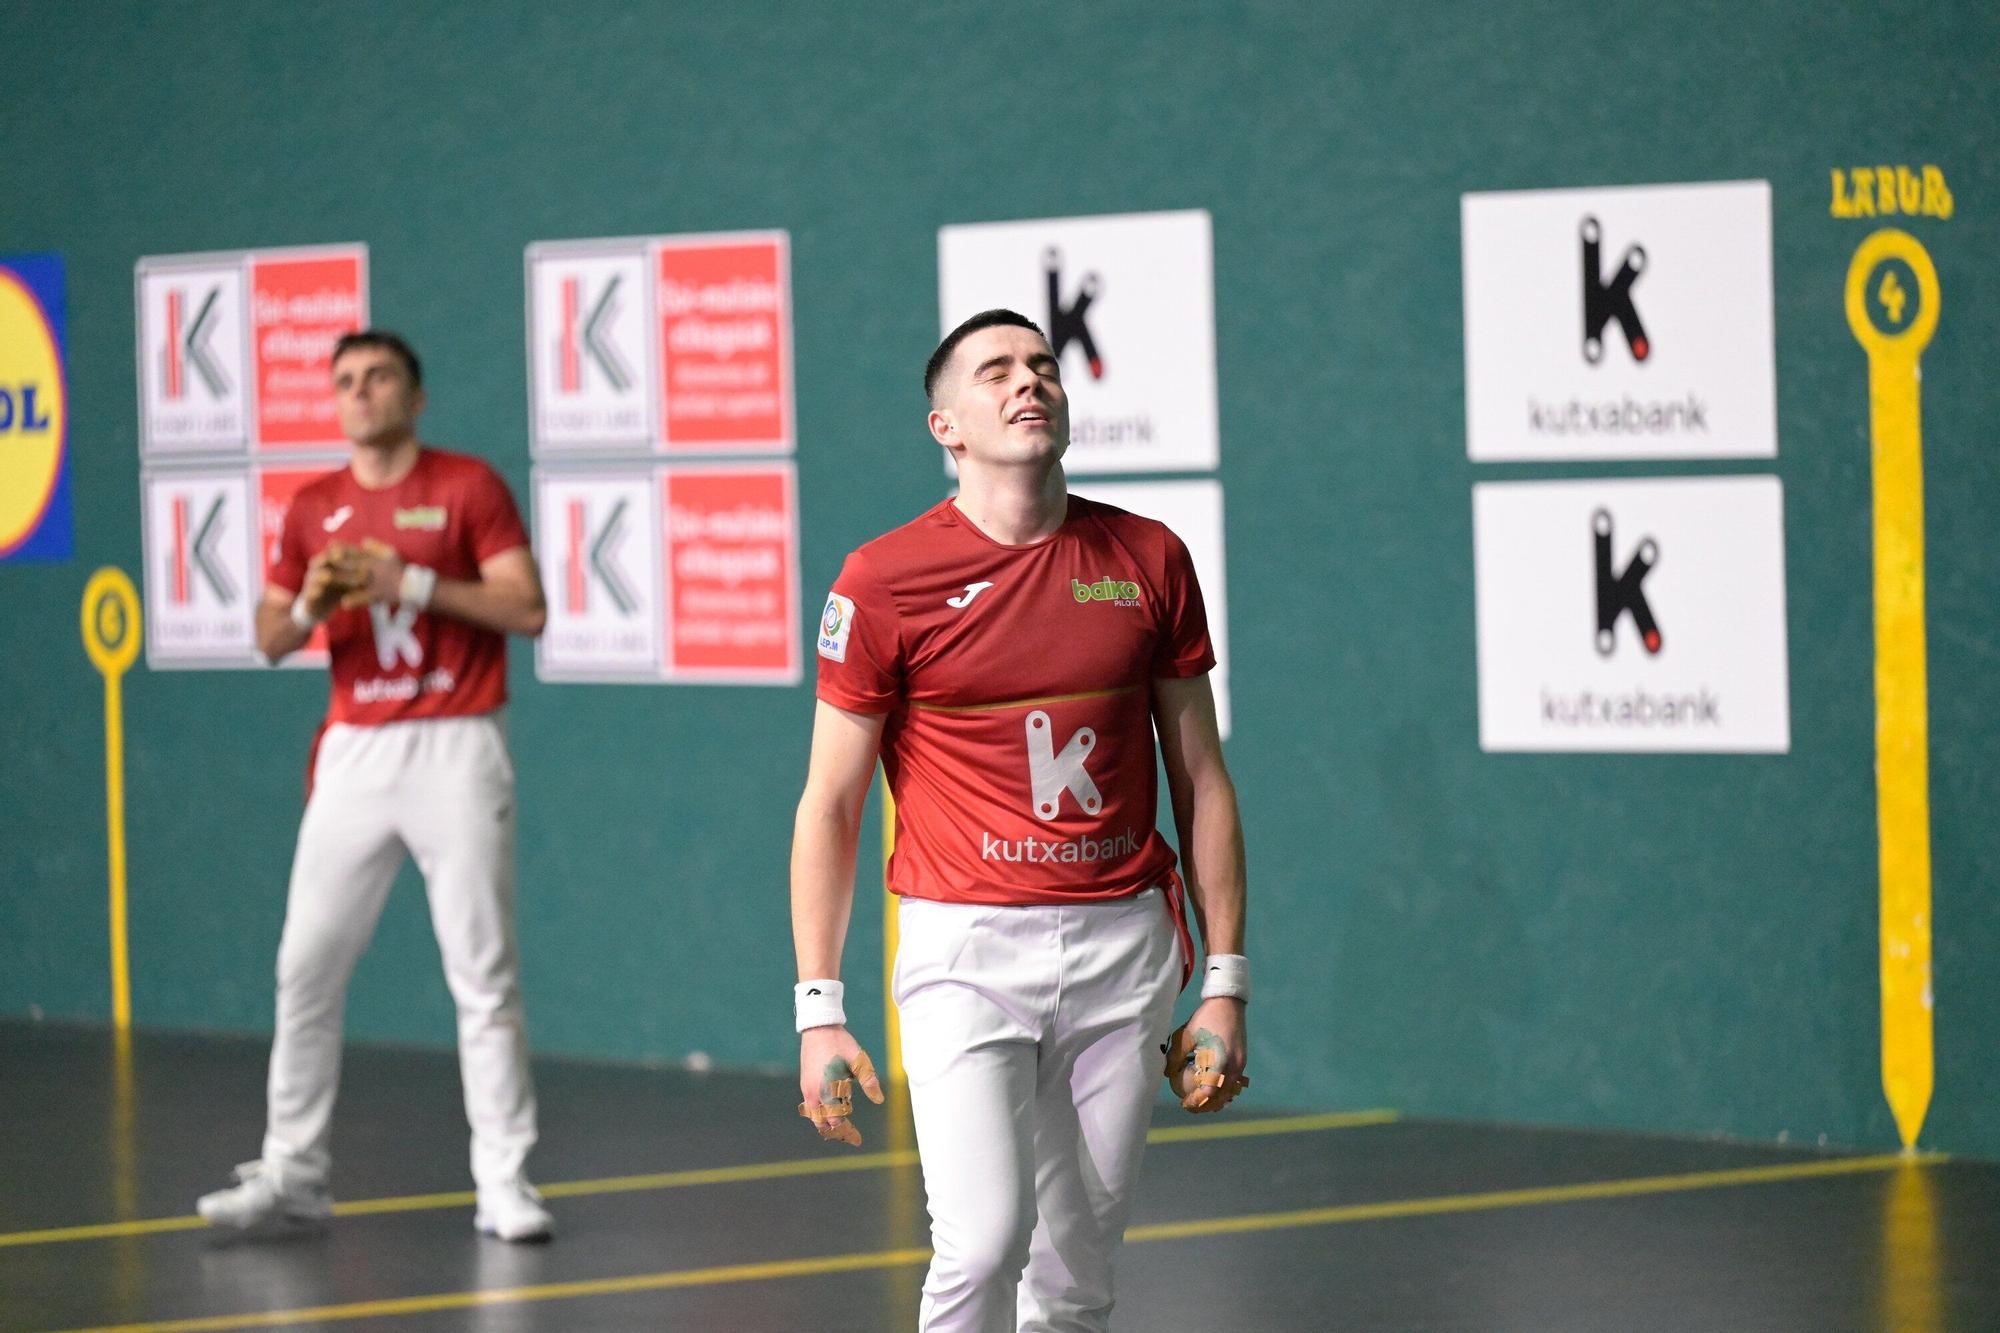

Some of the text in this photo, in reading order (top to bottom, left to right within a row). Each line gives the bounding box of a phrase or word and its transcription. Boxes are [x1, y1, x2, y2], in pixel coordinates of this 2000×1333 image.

[1878, 271, 1905, 323] 4
[1528, 396, 1707, 434] kutxabank
[1071, 576, 1140, 603] baiko
[1541, 687, 1718, 726] kutxabank
[981, 827, 1141, 863] kutxabank
